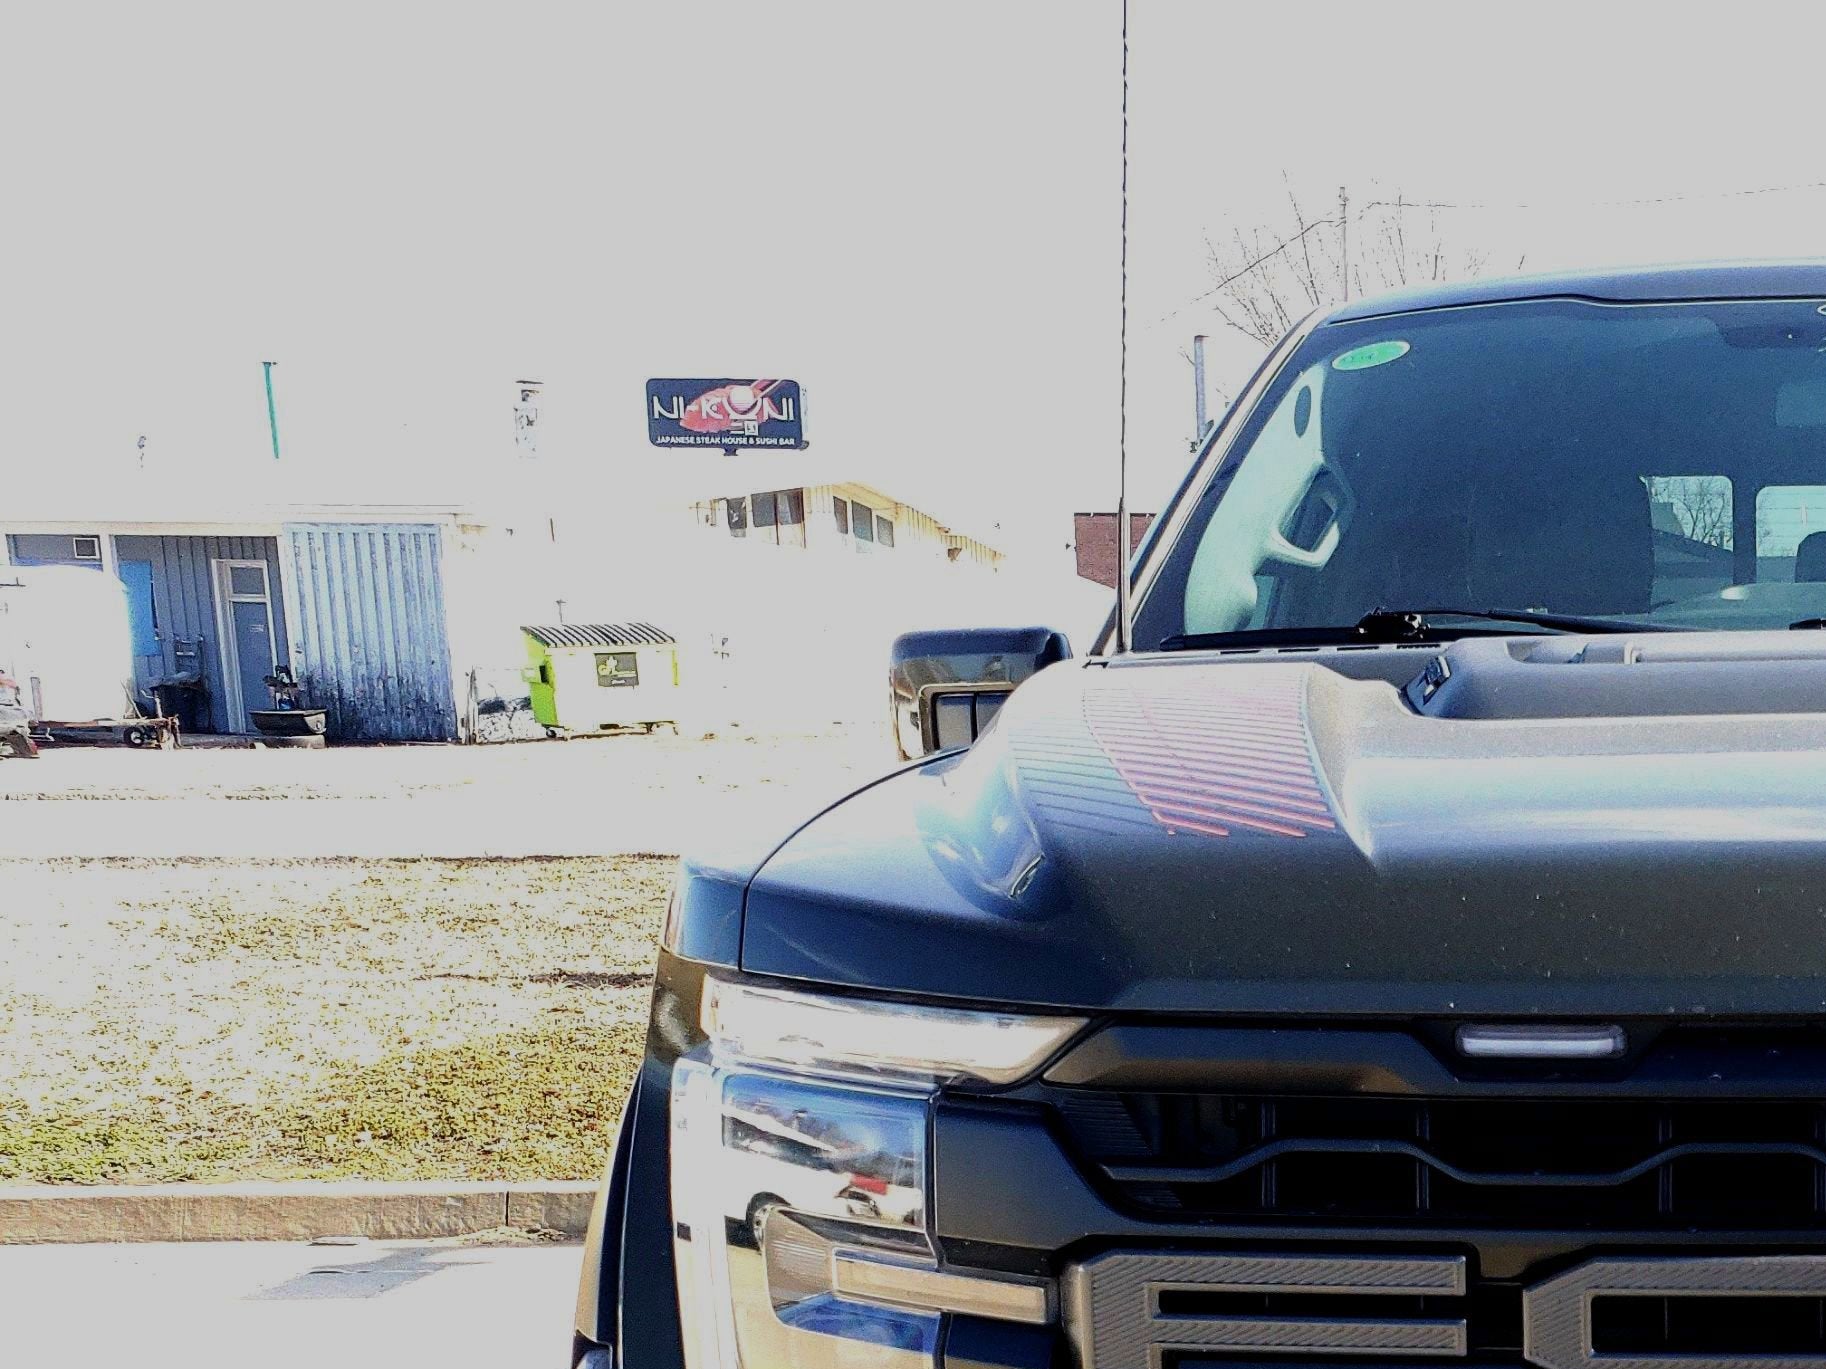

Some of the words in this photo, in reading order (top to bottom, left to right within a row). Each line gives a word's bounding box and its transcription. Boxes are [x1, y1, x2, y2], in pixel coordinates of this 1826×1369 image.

[656, 435, 695, 444] JAPANESE
[696, 435, 720, 445] STEAK
[721, 436, 747, 445] HOUSE
[756, 437, 778, 445] SUSHI
[779, 437, 795, 446] BAR
